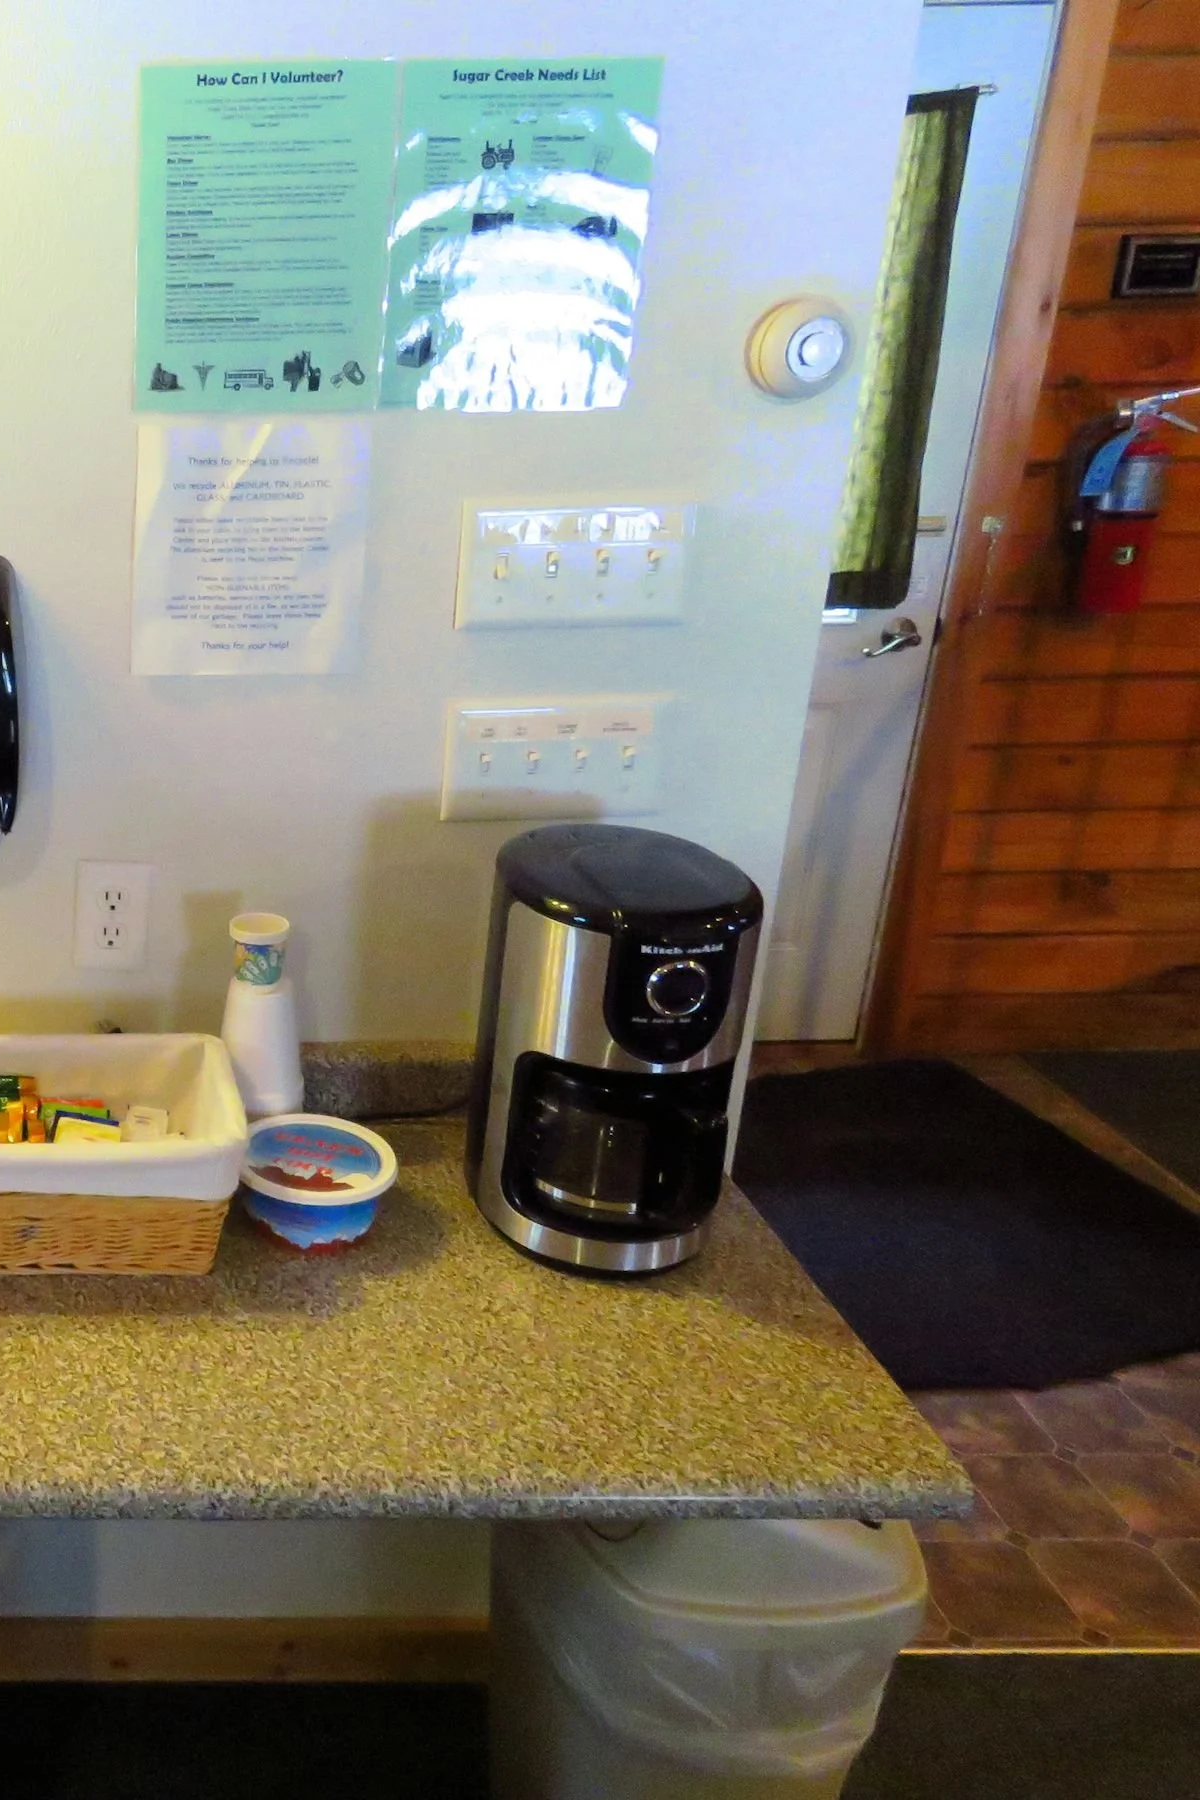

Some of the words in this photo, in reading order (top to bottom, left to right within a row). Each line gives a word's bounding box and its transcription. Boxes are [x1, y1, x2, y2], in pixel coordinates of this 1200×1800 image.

[196, 74, 228, 87] How
[231, 73, 258, 85] Can
[262, 72, 267, 84] I
[270, 70, 345, 84] Volunteer?
[452, 69, 491, 84] Sugar
[494, 69, 535, 82] Creek
[538, 69, 579, 82] Needs
[583, 68, 607, 81] List
[188, 456, 218, 466] Thanks
[220, 456, 232, 466] for
[201, 642, 230, 650] Thanks
[232, 641, 244, 650] for
[247, 643, 266, 651] your
